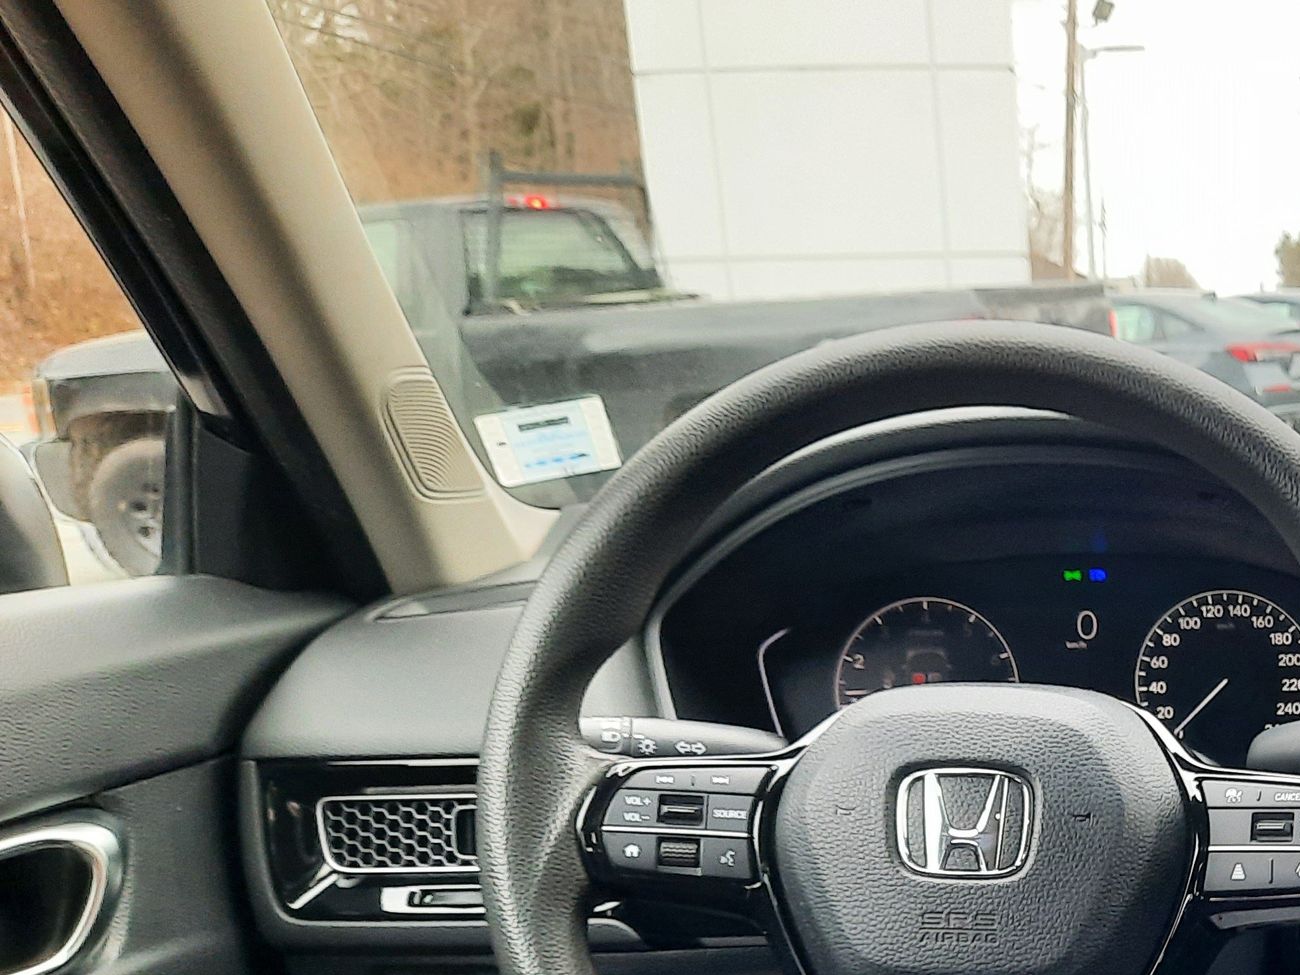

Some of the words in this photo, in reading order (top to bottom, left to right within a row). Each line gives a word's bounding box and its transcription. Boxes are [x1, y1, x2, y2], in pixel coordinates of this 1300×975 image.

[1201, 604, 1224, 617] 120
[1228, 604, 1251, 617] 140
[1077, 610, 1098, 640] 0
[1178, 616, 1201, 630] 100
[1251, 616, 1274, 628] 160
[1162, 633, 1180, 647] 80
[1270, 633, 1292, 645] 180
[1150, 656, 1168, 669] 60
[1149, 681, 1167, 694] 40
[1156, 705, 1174, 719] 20
[712, 809, 748, 820] SOURCE
[919, 932, 997, 944] AIRBAG
